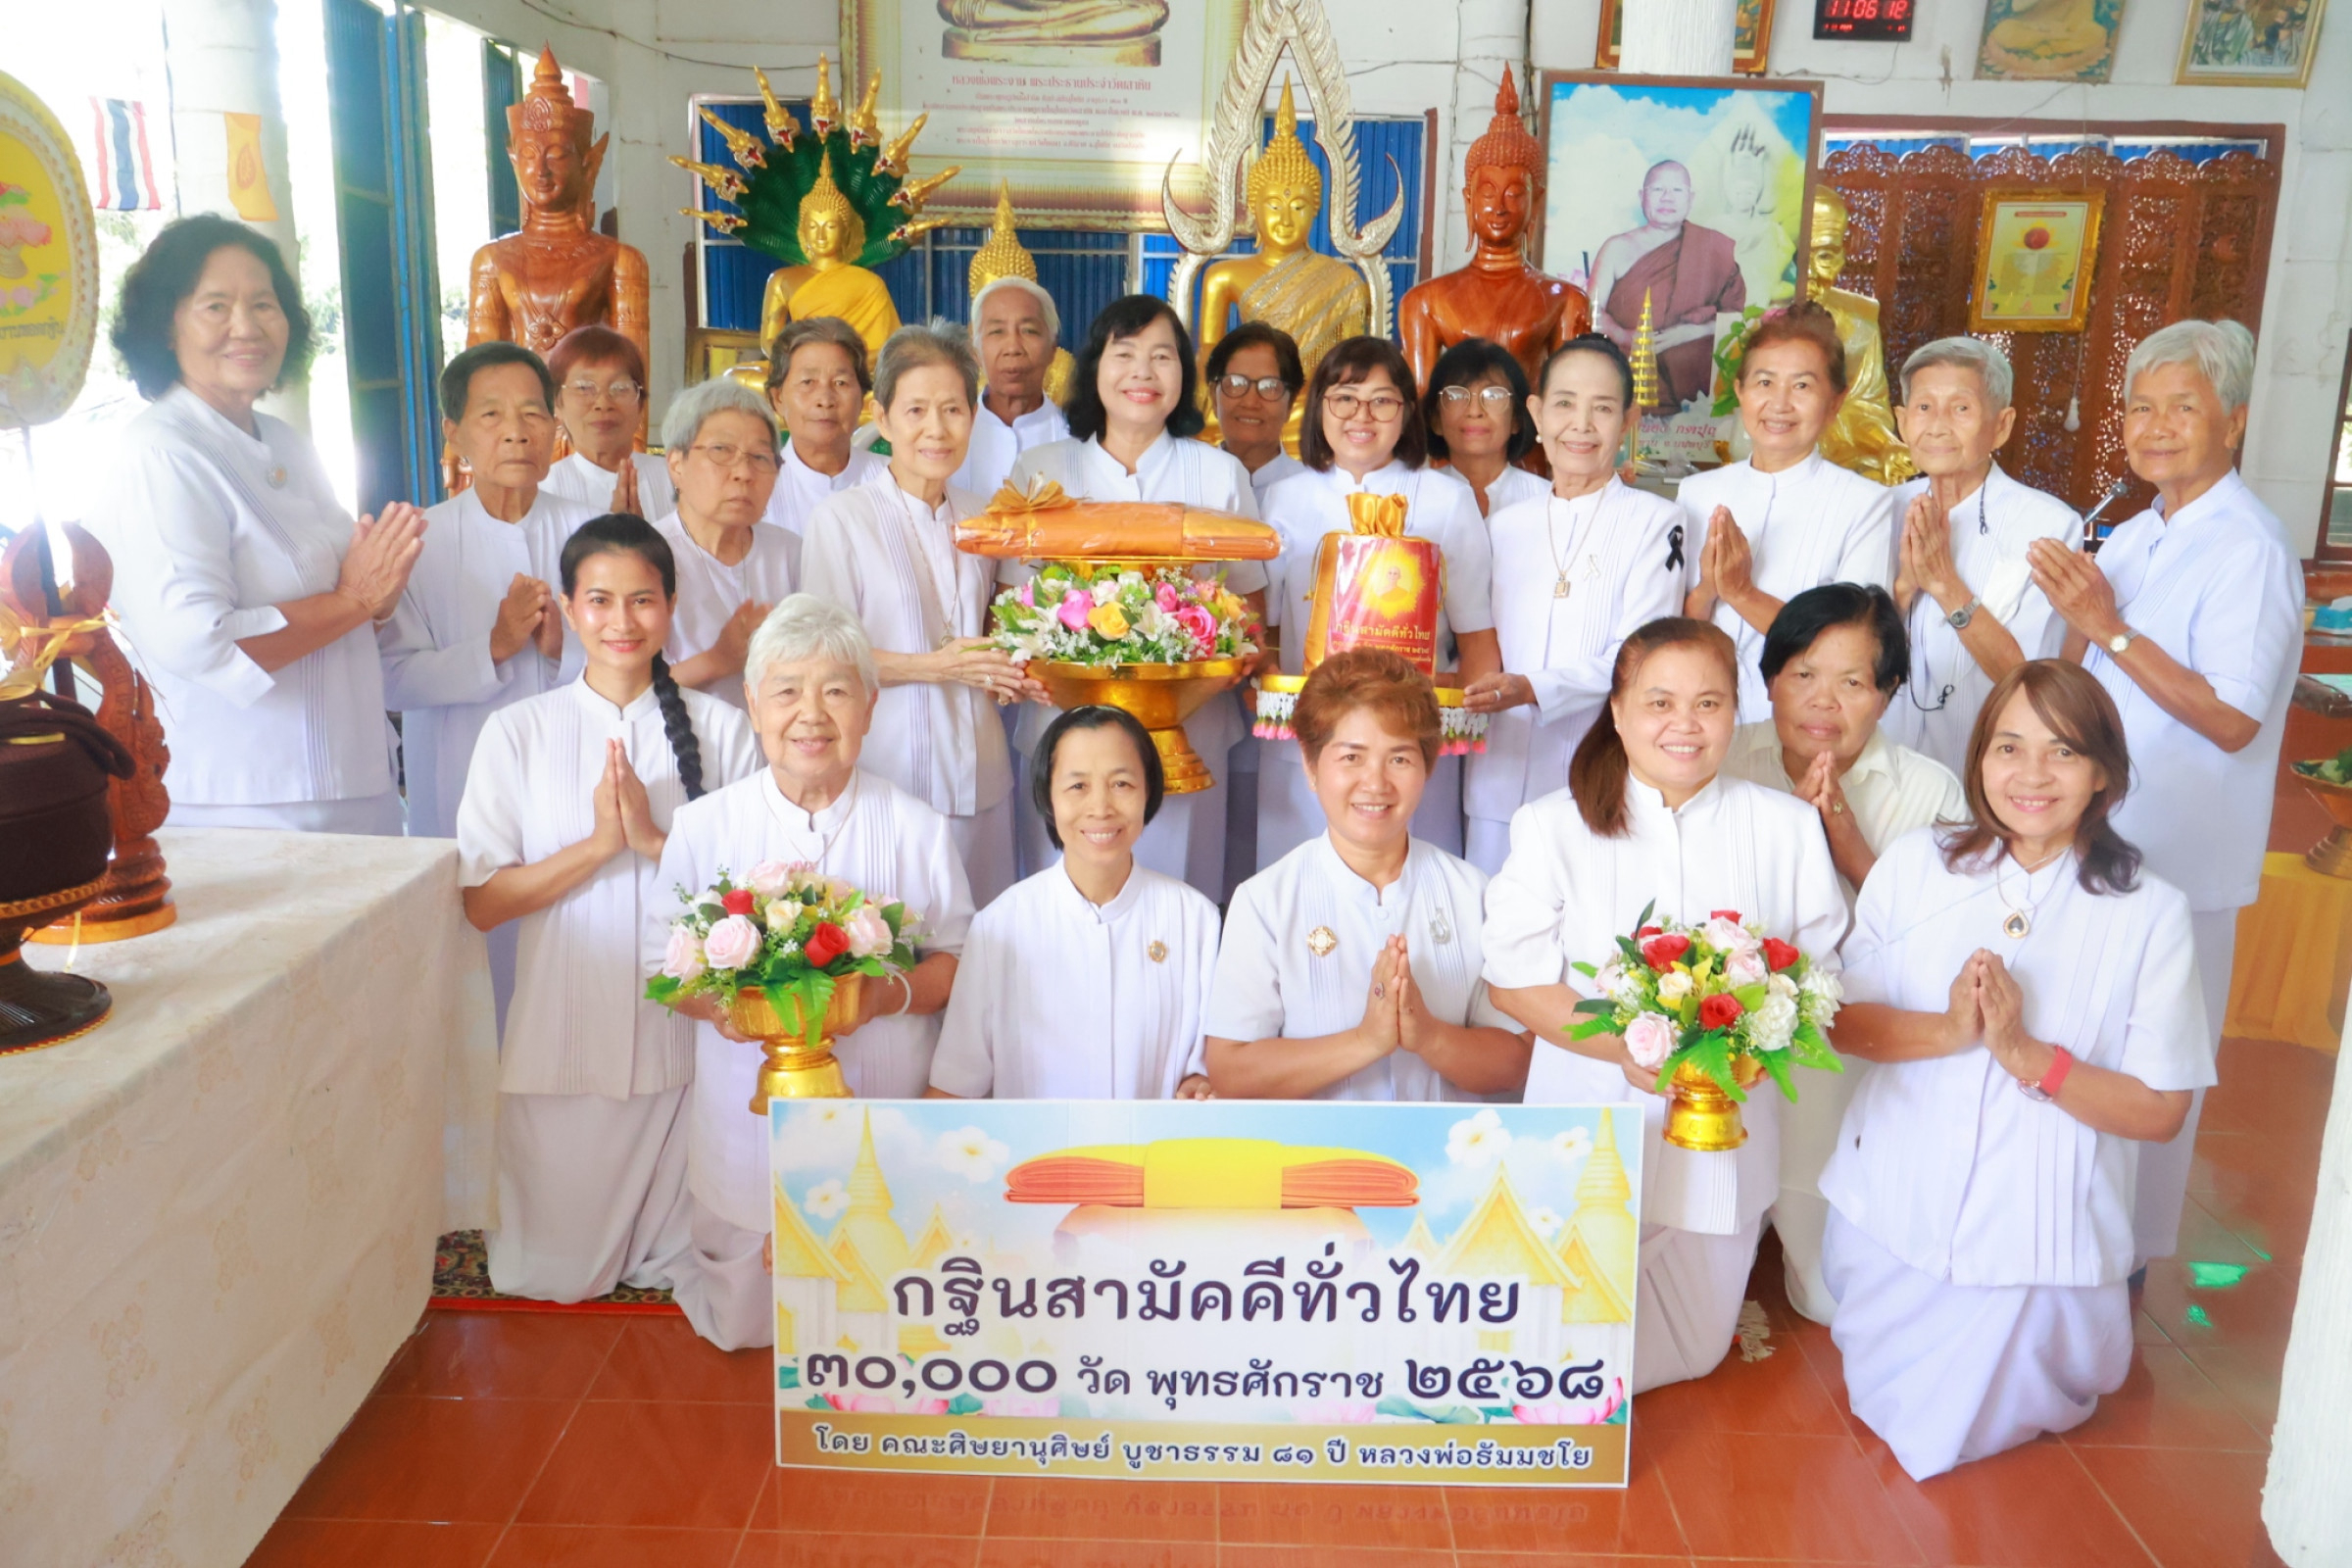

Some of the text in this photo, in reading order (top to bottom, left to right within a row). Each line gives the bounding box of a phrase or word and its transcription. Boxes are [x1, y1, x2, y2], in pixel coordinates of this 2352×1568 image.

[894, 1242, 1519, 1336] กฐินสามัคคีทั่วไทย
[807, 1353, 1604, 1410] ๓๐,๐๐๐ วัด พุทธศักราช ๒๕๖๘
[815, 1425, 1589, 1469] โดย คณะศิษยานุศิษย์ บูชาธรรม ๘๑ ปี หลวงพ่อธัมมชโย
